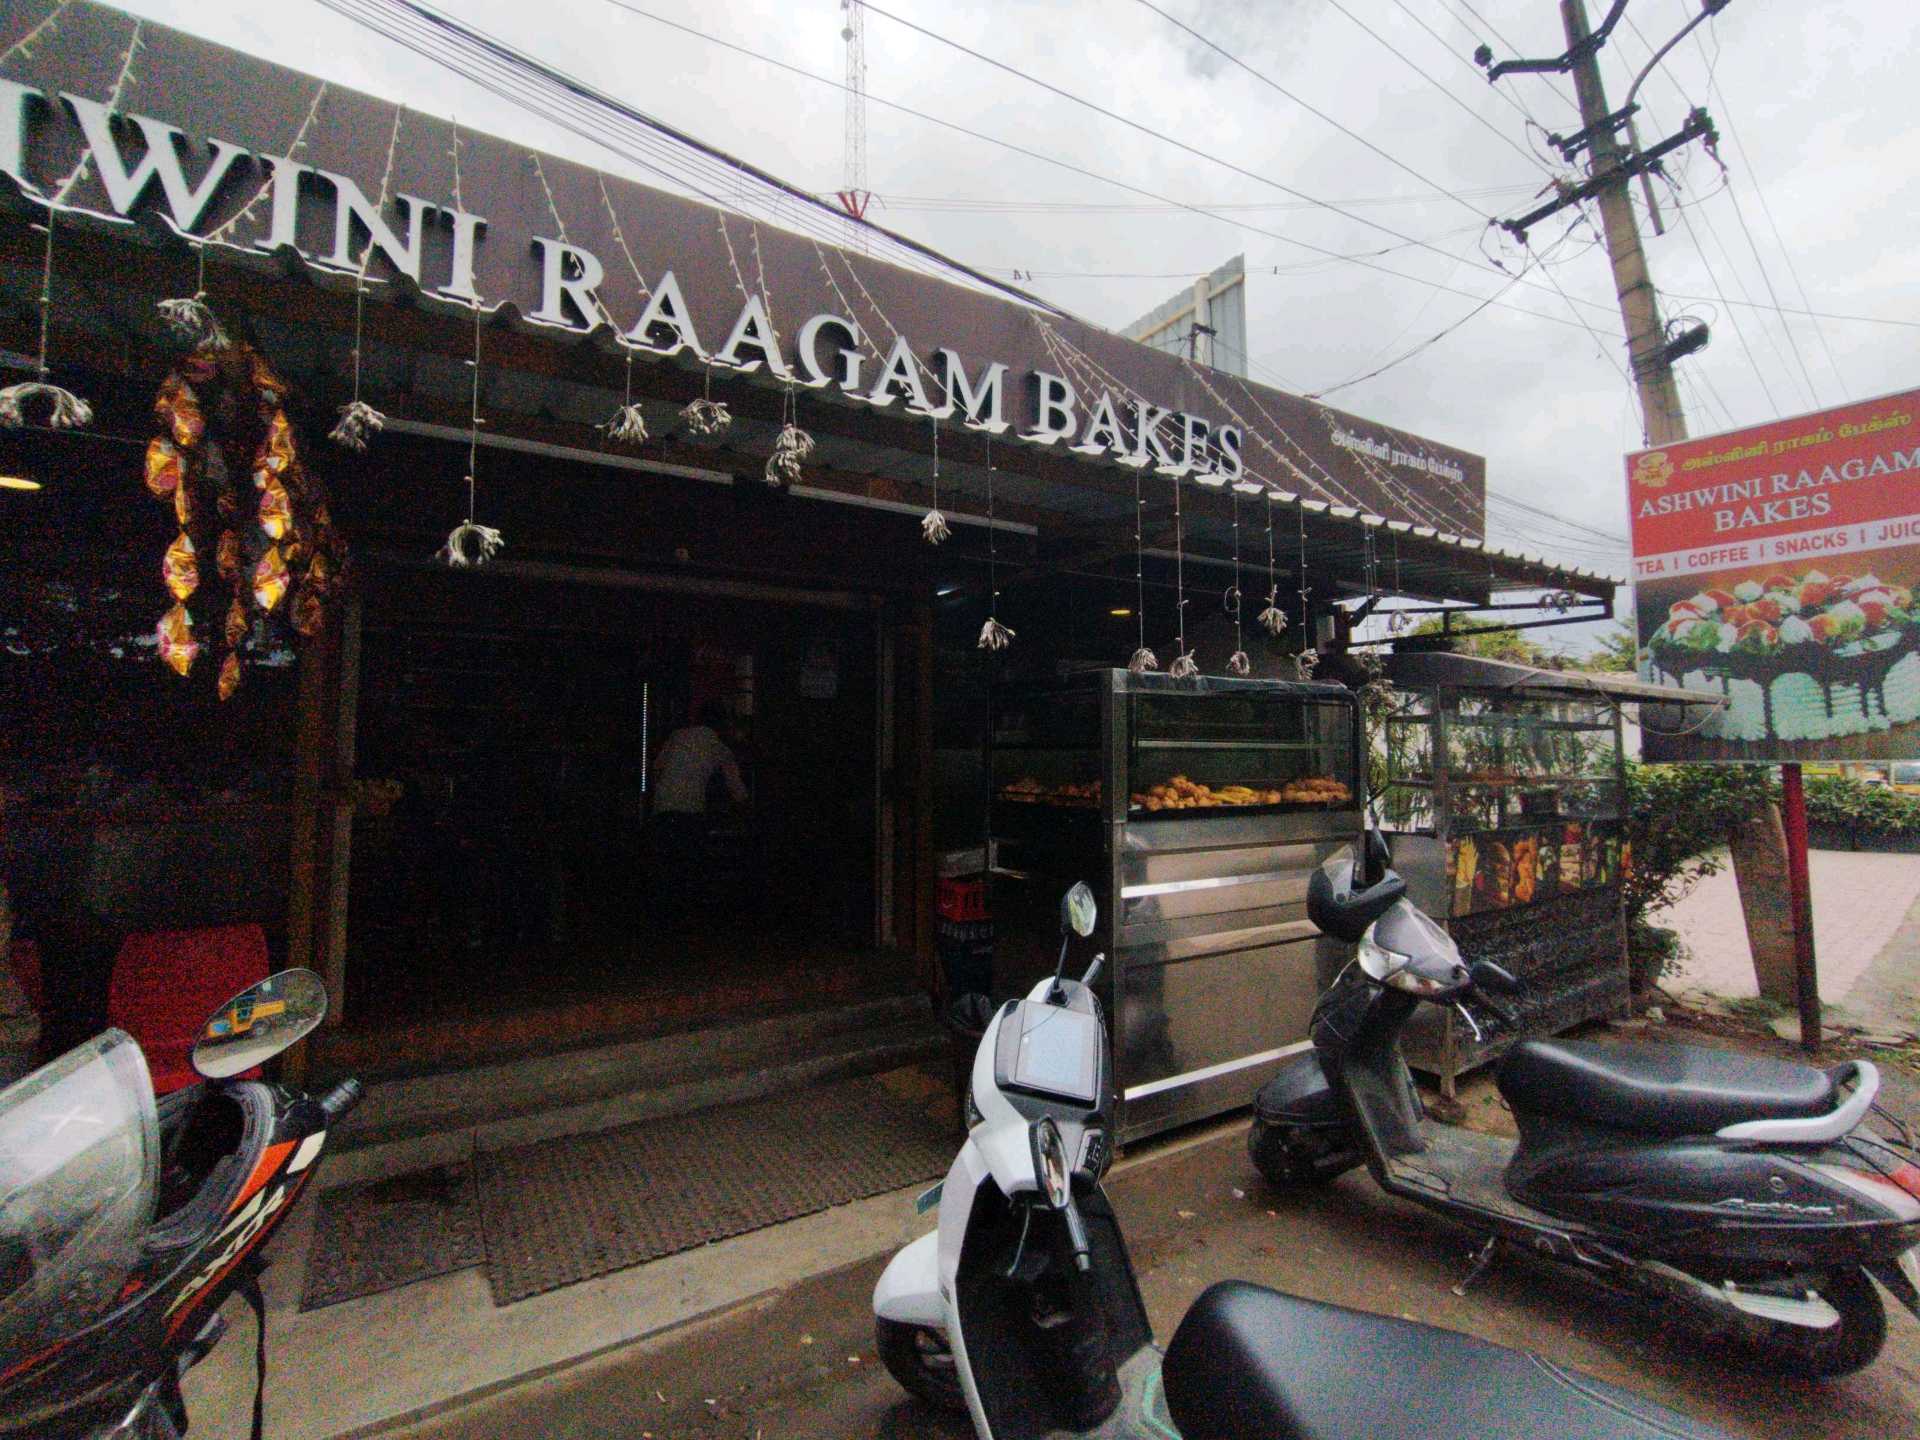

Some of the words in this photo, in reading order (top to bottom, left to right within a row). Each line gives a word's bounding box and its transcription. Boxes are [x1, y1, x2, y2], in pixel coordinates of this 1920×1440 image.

[530, 234, 1010, 434] RAAGAM
[1032, 367, 1244, 482] BAKES
[1638, 478, 1766, 519] ASHWINI
[1770, 446, 1920, 496] RAAGAM
[1713, 491, 1833, 533] BAKES
[1635, 559, 1666, 575] TEA
[1687, 546, 1749, 568] COFFEE
[1774, 531, 1848, 556] SNACKS
